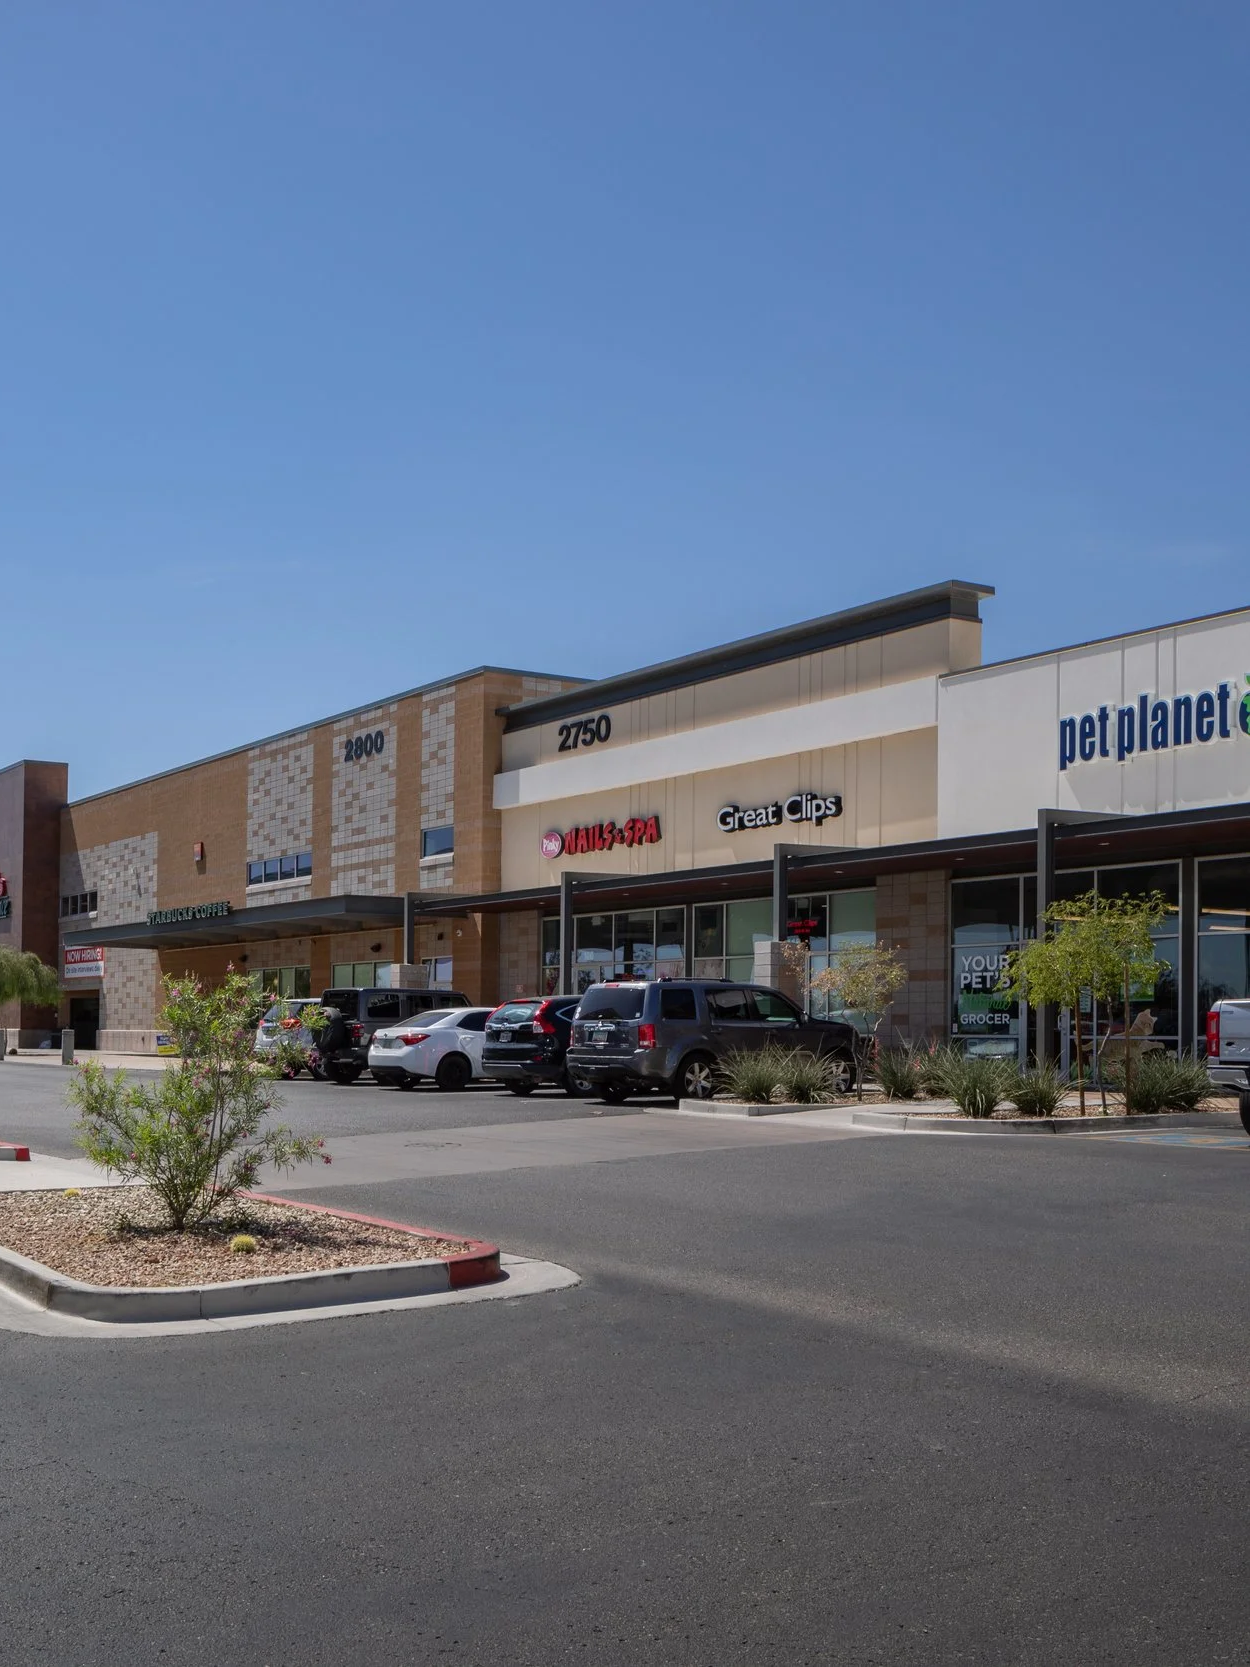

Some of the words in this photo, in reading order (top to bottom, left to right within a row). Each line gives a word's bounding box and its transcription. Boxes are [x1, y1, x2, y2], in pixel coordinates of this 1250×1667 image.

[558, 714, 612, 752] 2750
[1059, 705, 1110, 771] pet
[1117, 682, 1232, 763] planet
[344, 730, 384, 762] 2800
[716, 805, 780, 832] Great
[783, 793, 840, 826] Clips
[564, 821, 616, 855] NAILS
[624, 816, 661, 848] SPA
[146, 906, 194, 926] STARBUCKS
[195, 902, 229, 919] COFFEE
[66, 951, 81, 963] NOW
[81, 948, 102, 962] HIRING!
[962, 955, 1011, 971] YOUR
[960, 972, 1011, 989] PET'S
[960, 1013, 1010, 1024] GROCER
